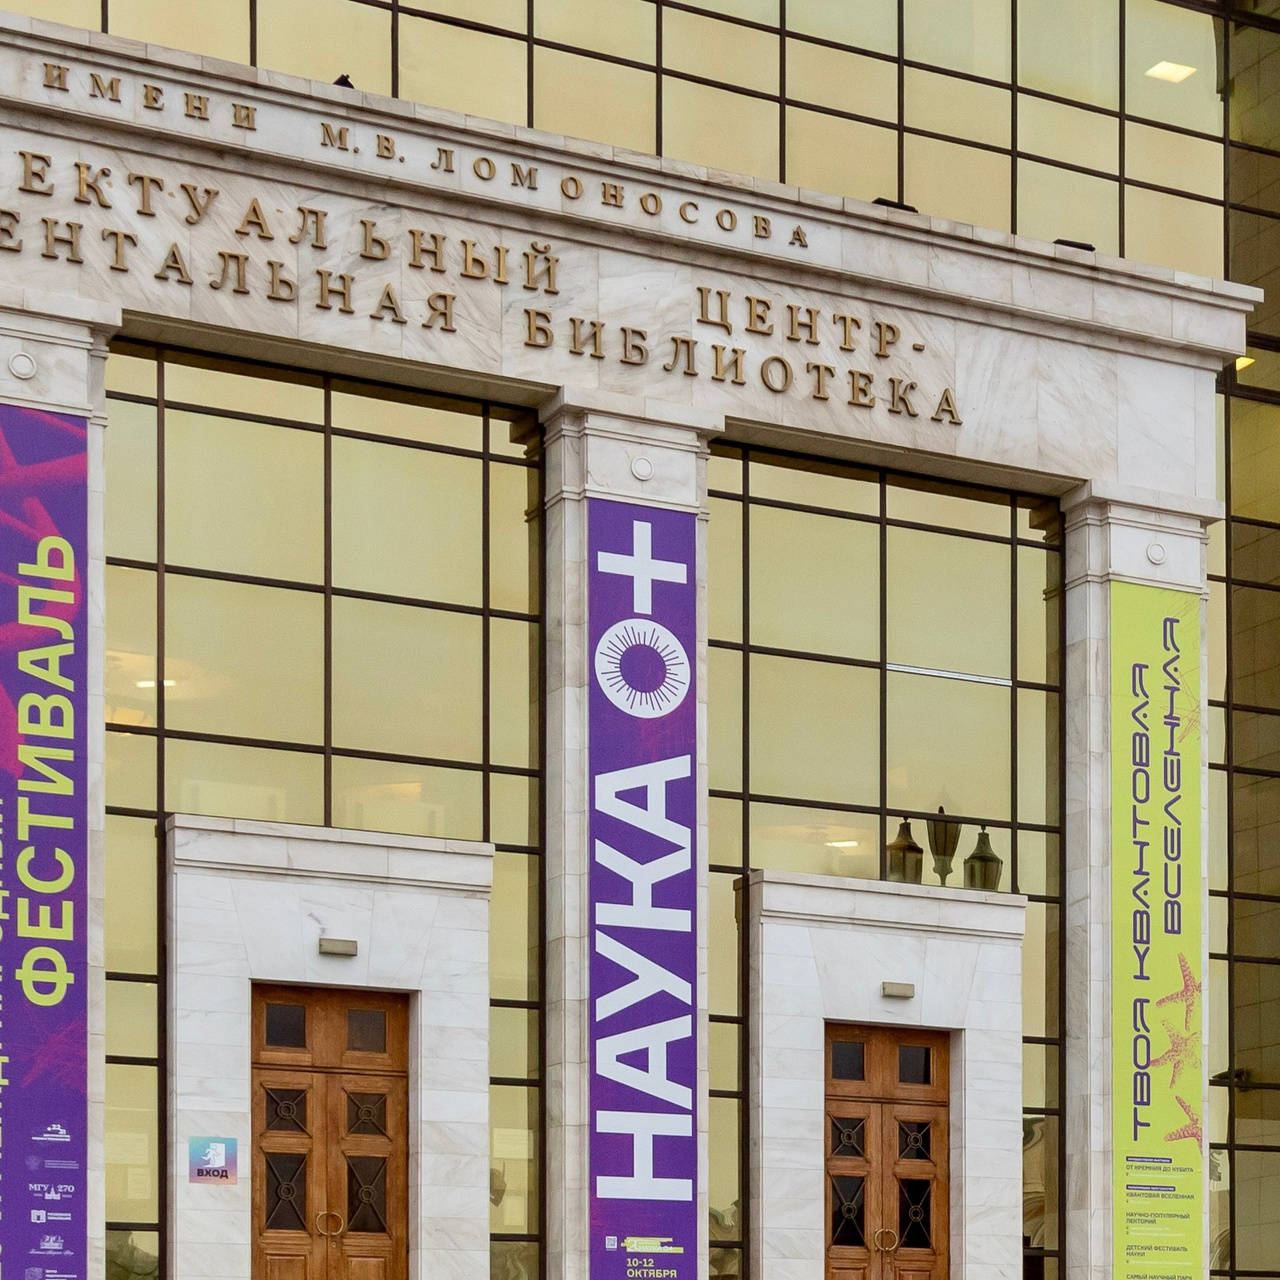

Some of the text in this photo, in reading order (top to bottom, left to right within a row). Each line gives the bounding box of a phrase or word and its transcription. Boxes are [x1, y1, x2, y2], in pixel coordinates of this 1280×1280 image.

[43, 62, 257, 130] ИМЕНИ
[18, 150, 560, 295] ЕКТУАЛЬНЫЙ
[524, 308, 963, 425] БИБЛИОТЕКА
[15, 535, 76, 1007] ФЕСТИВАЛЬ
[1132, 663, 1150, 981] КВАНТОВАЯ
[1163, 617, 1182, 935] ВСЕЛЕННАЯ
[594, 754, 692, 1202] НАУКА
[1132, 998, 1151, 1142] ТВОЯ
[29, 1184, 75, 1193] МГУ 270
[196, 1168, 229, 1180] ВХОД
[626, 1258, 655, 1267] 10-12
[626, 1268, 677, 1278] ОКТЯБРЯ
